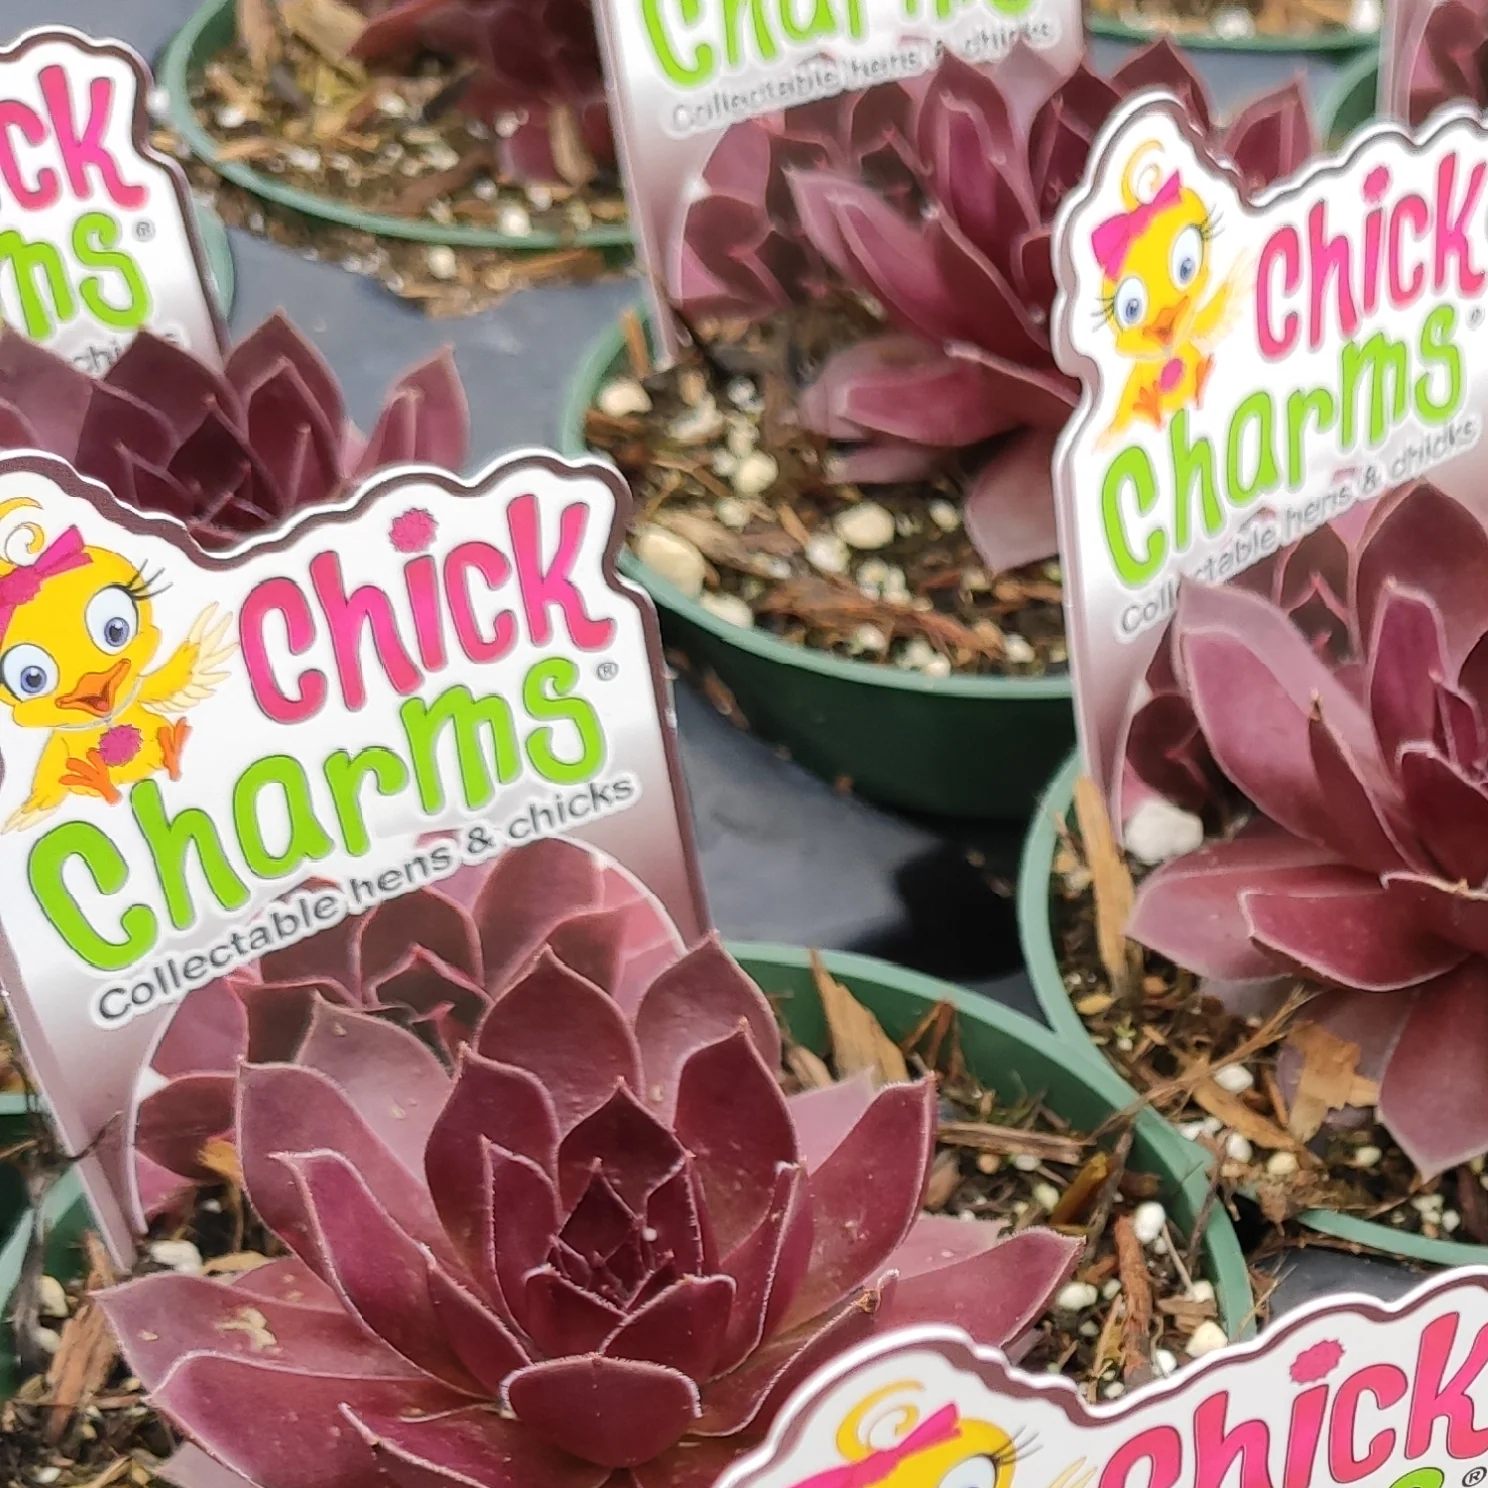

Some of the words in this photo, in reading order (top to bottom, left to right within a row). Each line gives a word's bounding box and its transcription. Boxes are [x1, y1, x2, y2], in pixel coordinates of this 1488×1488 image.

[1255, 153, 1486, 359] Chick
[1100, 306, 1463, 585] Charms
[239, 493, 616, 723] Chick
[1120, 525, 1275, 634] Colltable
[28, 656, 605, 970] Charms
[98, 890, 341, 1022] Collectable
[349, 845, 452, 902] hens
[467, 826, 496, 855] &
[507, 775, 635, 840] chicks
